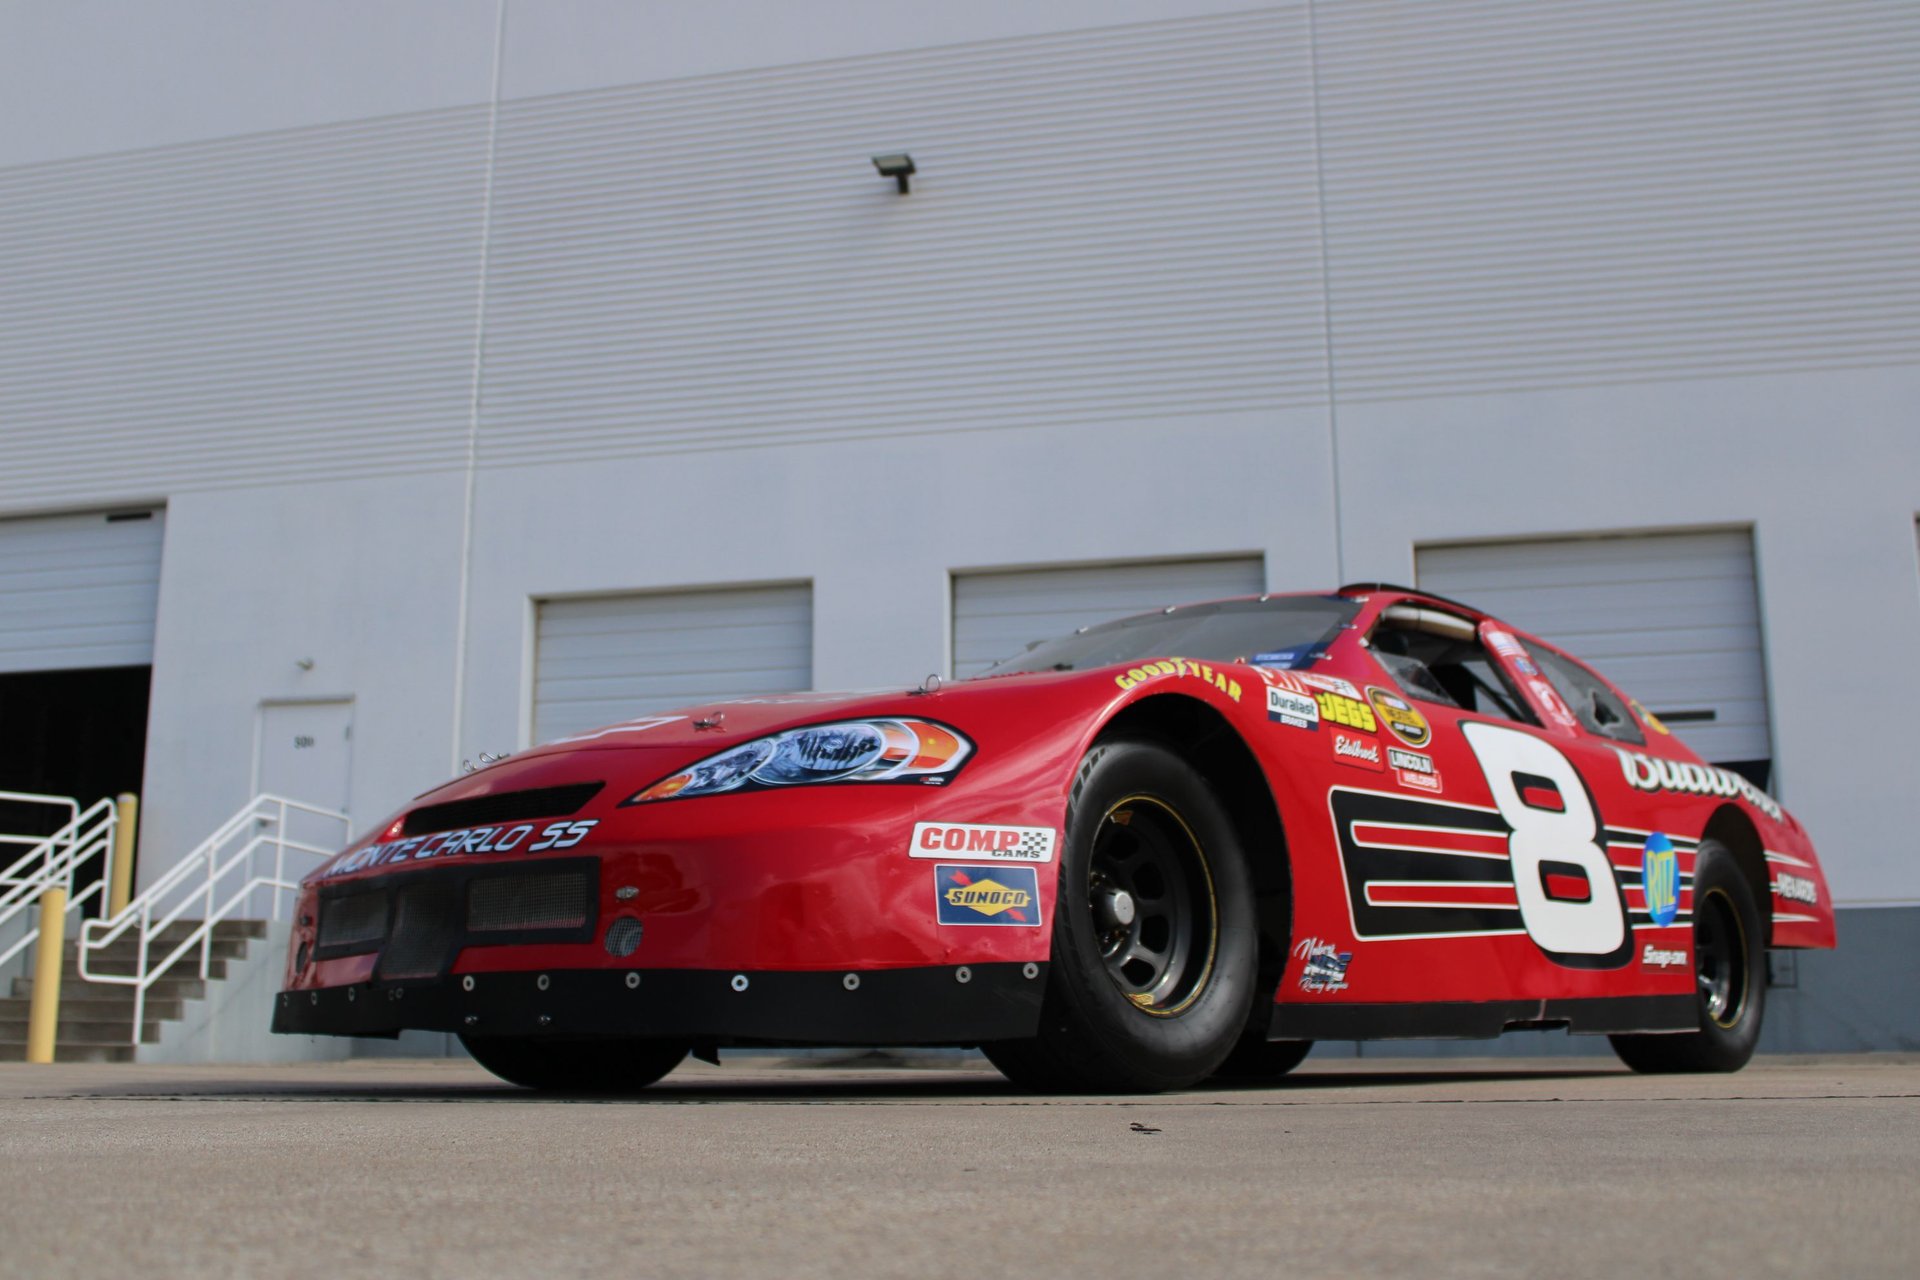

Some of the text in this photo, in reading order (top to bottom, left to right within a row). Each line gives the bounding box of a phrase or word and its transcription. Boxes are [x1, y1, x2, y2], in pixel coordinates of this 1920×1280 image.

[1115, 657, 1242, 702] GOODYEAR
[1270, 691, 1316, 717] Duralast
[1315, 691, 1378, 733] JEGS
[1390, 751, 1433, 774] LINCOLN
[322, 819, 600, 878] MONTE CARLO SS
[919, 827, 1021, 852] COMP
[1462, 721, 1625, 955] 8
[990, 849, 1042, 860] CAMS
[951, 890, 1027, 905] SUNOCO
